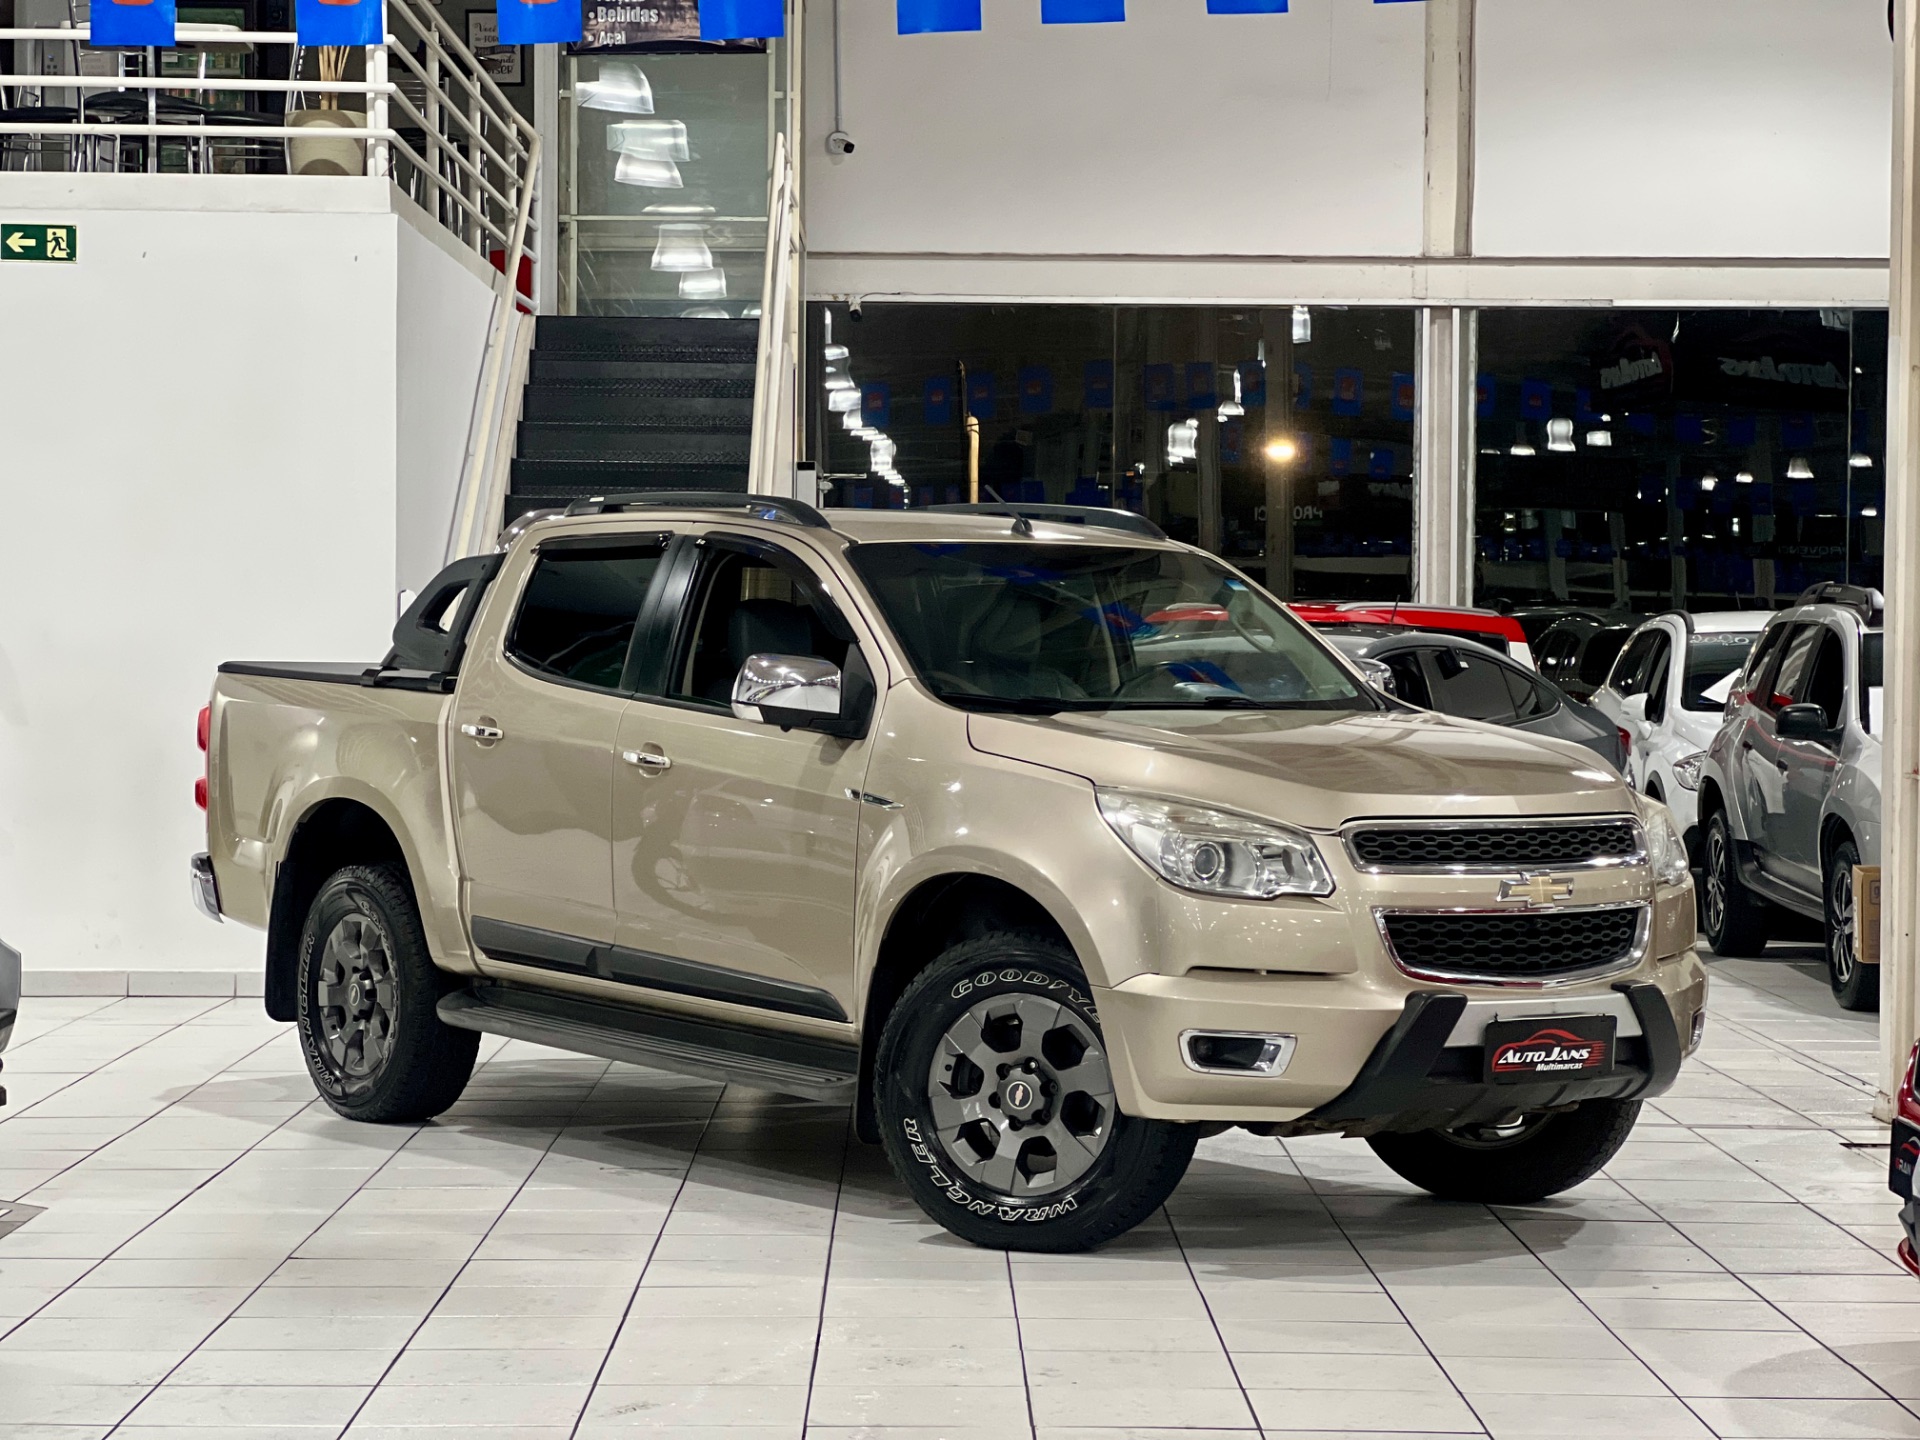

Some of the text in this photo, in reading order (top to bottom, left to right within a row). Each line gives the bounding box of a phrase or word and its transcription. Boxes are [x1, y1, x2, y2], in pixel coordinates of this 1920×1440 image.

[596, 6, 659, 23] Bebidas
[1535, 1062, 1583, 1072] Multimarcas
[903, 1117, 1078, 1222] WRANGLER
